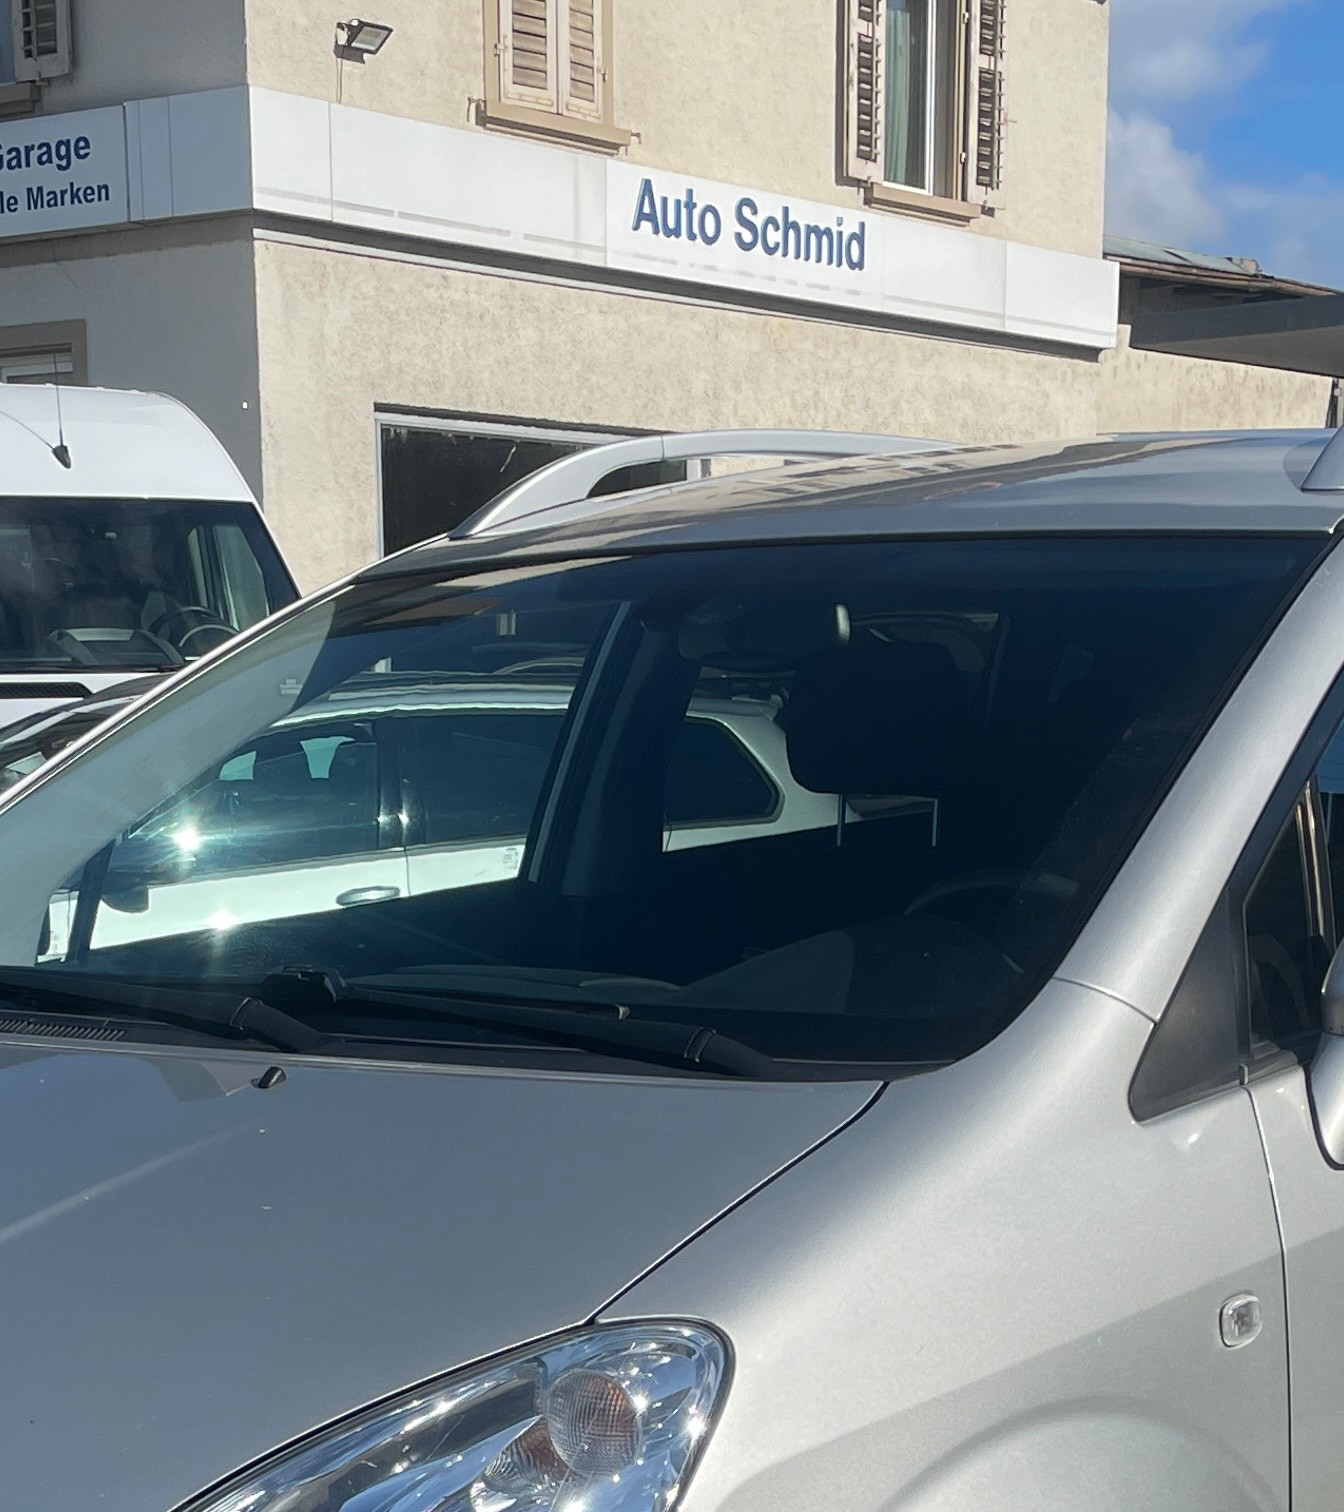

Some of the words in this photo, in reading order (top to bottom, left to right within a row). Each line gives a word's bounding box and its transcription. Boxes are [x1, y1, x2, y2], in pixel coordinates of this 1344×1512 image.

[25, 181, 111, 211] Marken
[631, 177, 722, 246] Auto
[733, 197, 867, 272] Schmid
